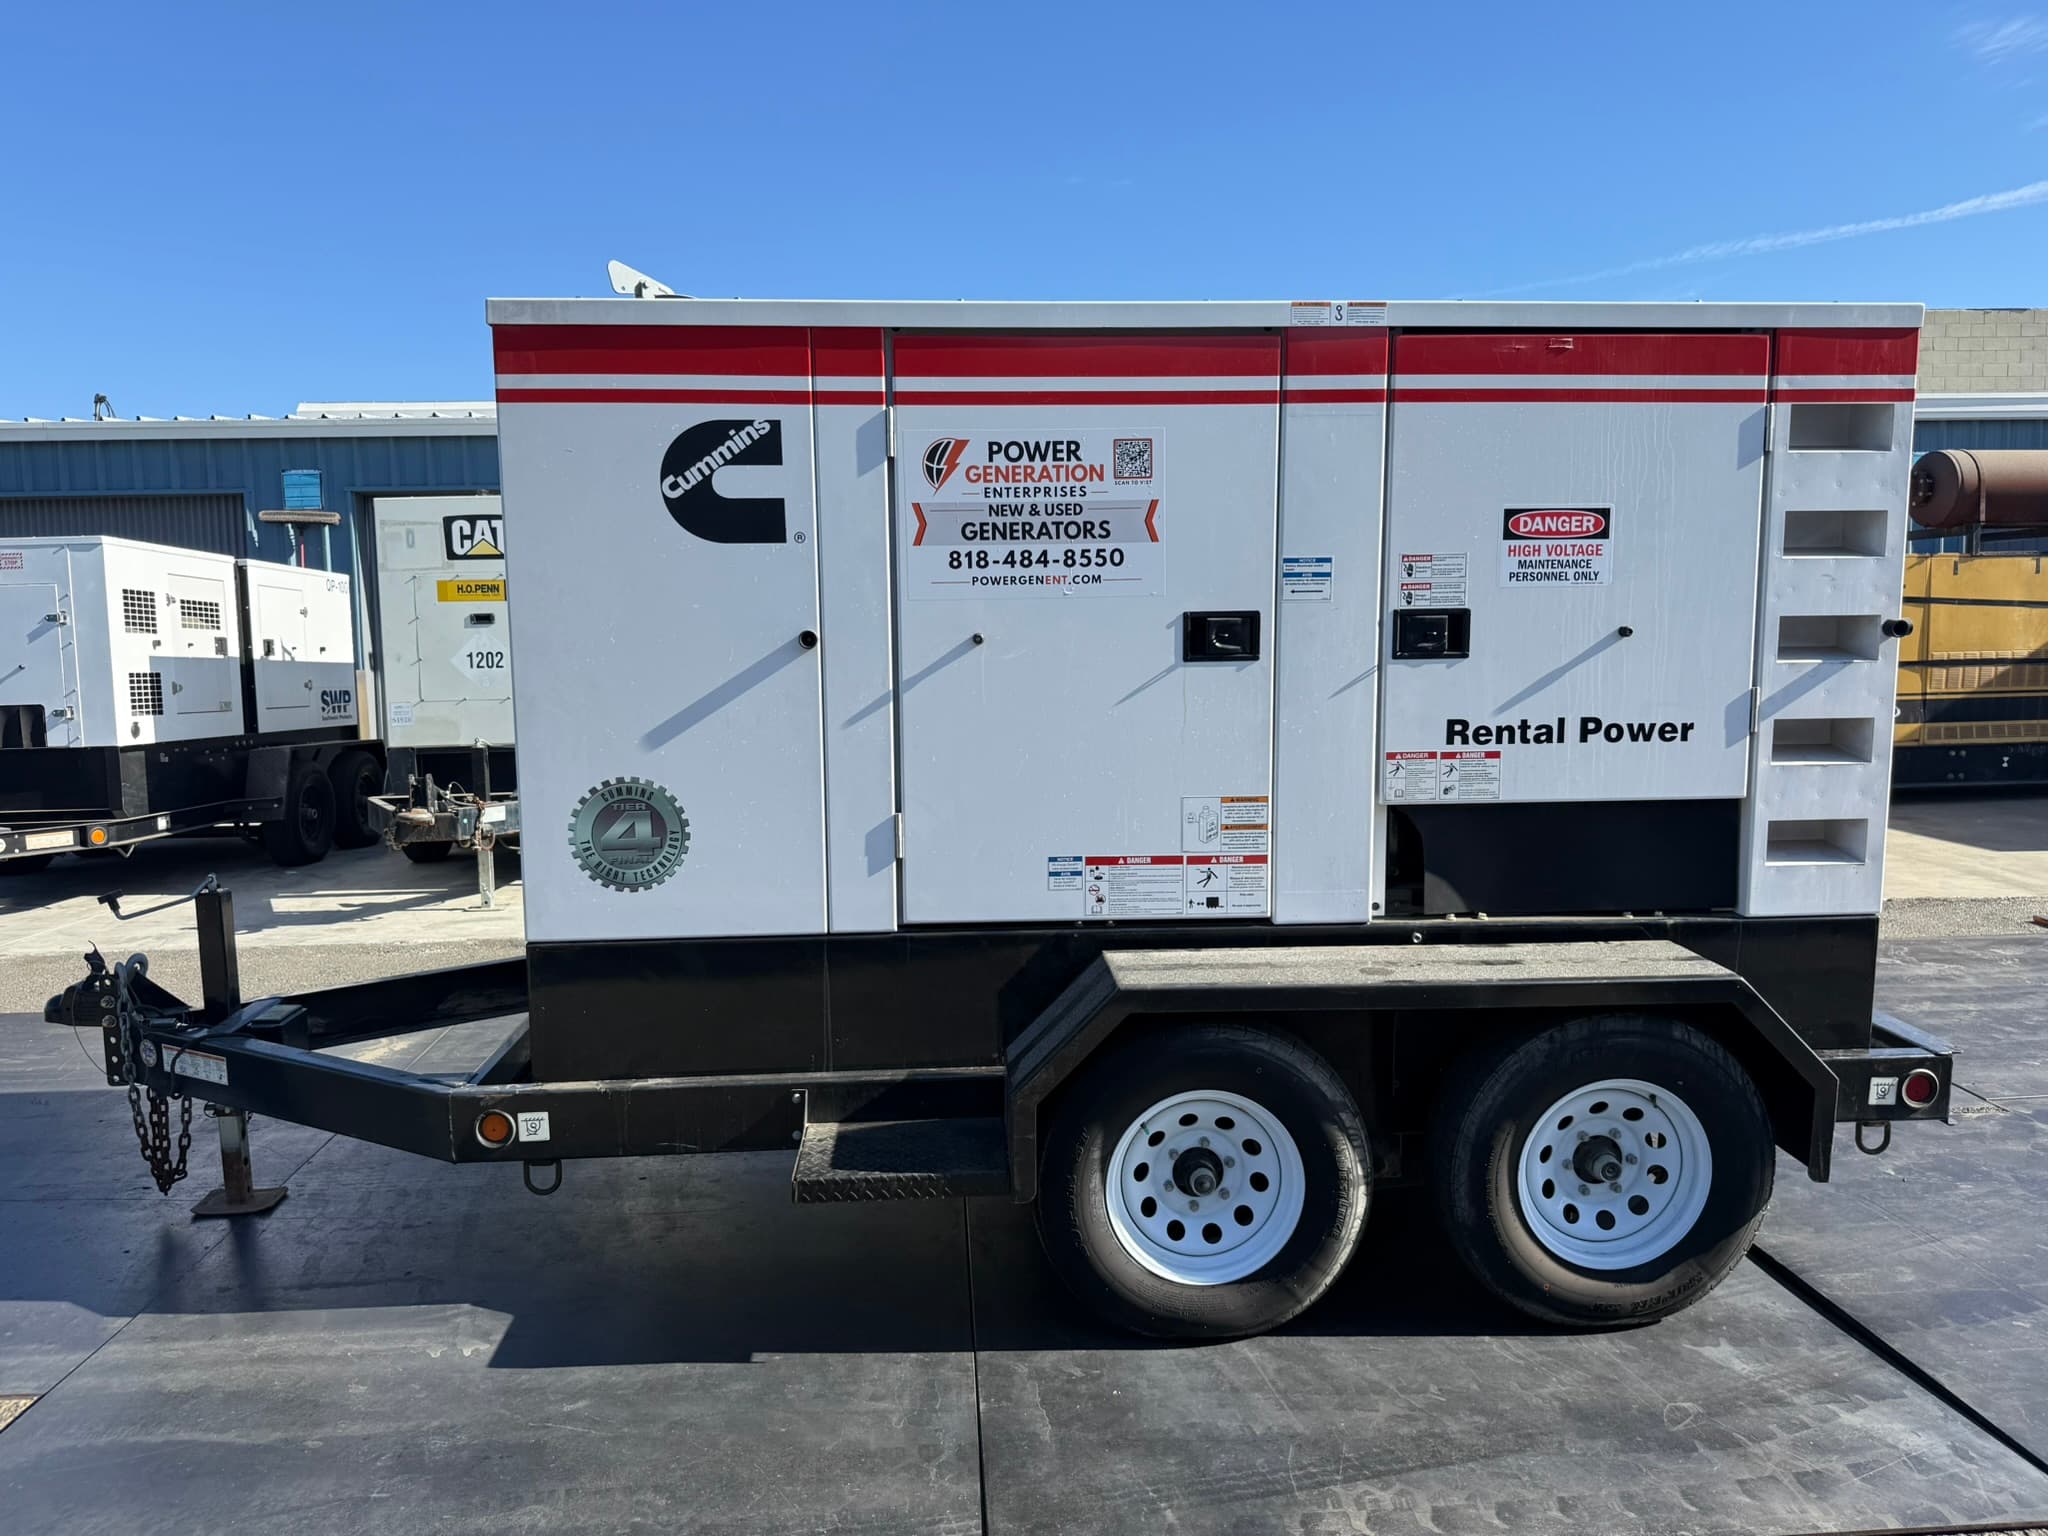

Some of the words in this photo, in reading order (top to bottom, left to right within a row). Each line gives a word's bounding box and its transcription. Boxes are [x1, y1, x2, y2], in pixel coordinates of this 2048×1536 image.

[661, 419, 771, 499] Cummins
[987, 440, 1082, 463] POWER
[965, 464, 1105, 484] GENERATION
[983, 486, 1087, 499] ENTERPRISES
[988, 504, 1025, 517] NEW
[1028, 503, 1041, 517] &
[1044, 503, 1083, 517] USED
[961, 520, 1111, 541] GENERATORS
[1519, 516, 1595, 533] DANGER
[948, 548, 1125, 569] 818-484-8550
[1507, 544, 1542, 557] HIGH
[1545, 544, 1604, 557] VOLTAGE
[1517, 559, 1593, 570] MAINTENANCE
[972, 574, 1102, 586] POWERGENENT.COM
[1508, 571, 1571, 582] PERSONNEL
[1573, 571, 1600, 581] ONLY
[466, 651, 504, 669] 1202
[320, 690, 352, 714] SWP
[1446, 717, 1566, 745] Rental
[1579, 717, 1694, 744] Power
[600, 785, 655, 802] CUMMINS
[600, 810, 663, 857] 4
[580, 839, 596, 860] THE
[593, 860, 627, 882] RIGHT
[634, 830, 680, 882] TECHNOLOGY
[1126, 856, 1152, 864] DANGER
[1219, 855, 1244, 863] DANGER
